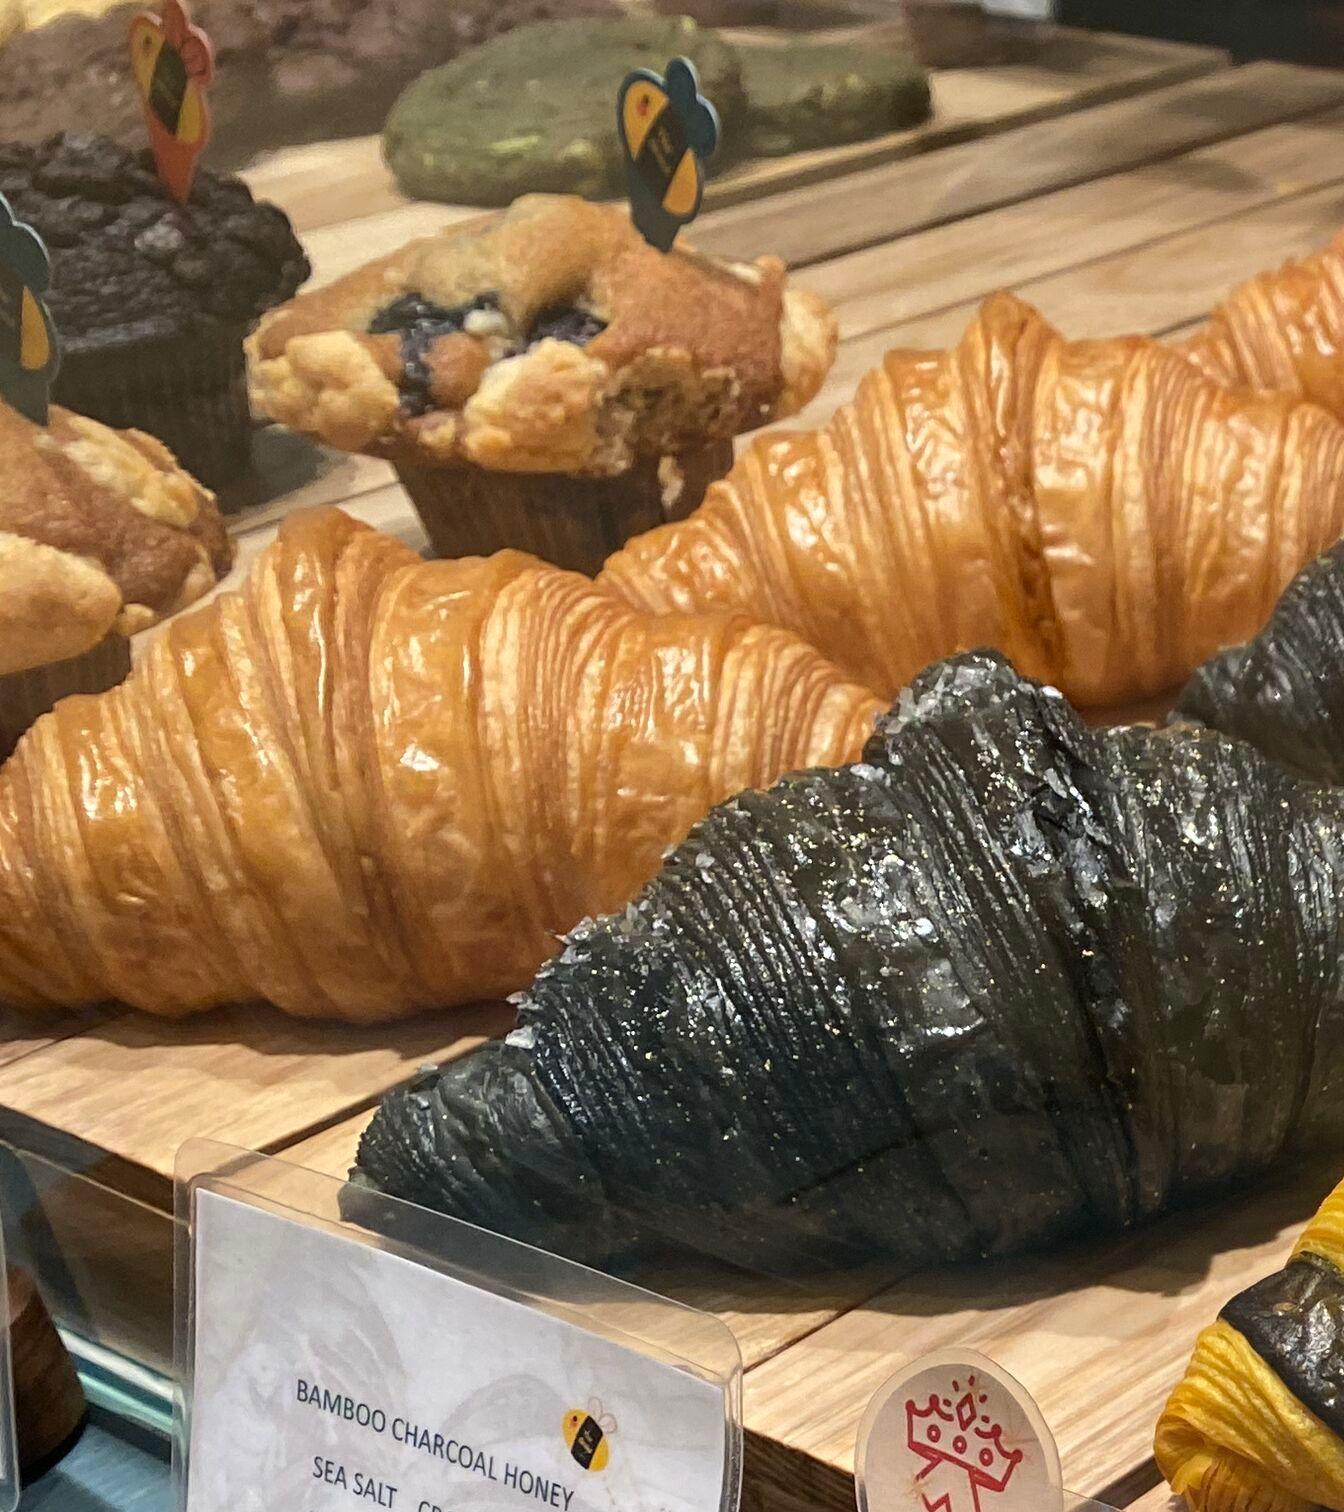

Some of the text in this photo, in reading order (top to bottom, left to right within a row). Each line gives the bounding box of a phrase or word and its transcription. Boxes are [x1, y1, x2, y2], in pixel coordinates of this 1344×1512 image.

[296, 1378, 575, 1512] BAMBOO CHARCOAL HONEY
[312, 1455, 347, 1491] SEA
[352, 1470, 398, 1509] SALT
